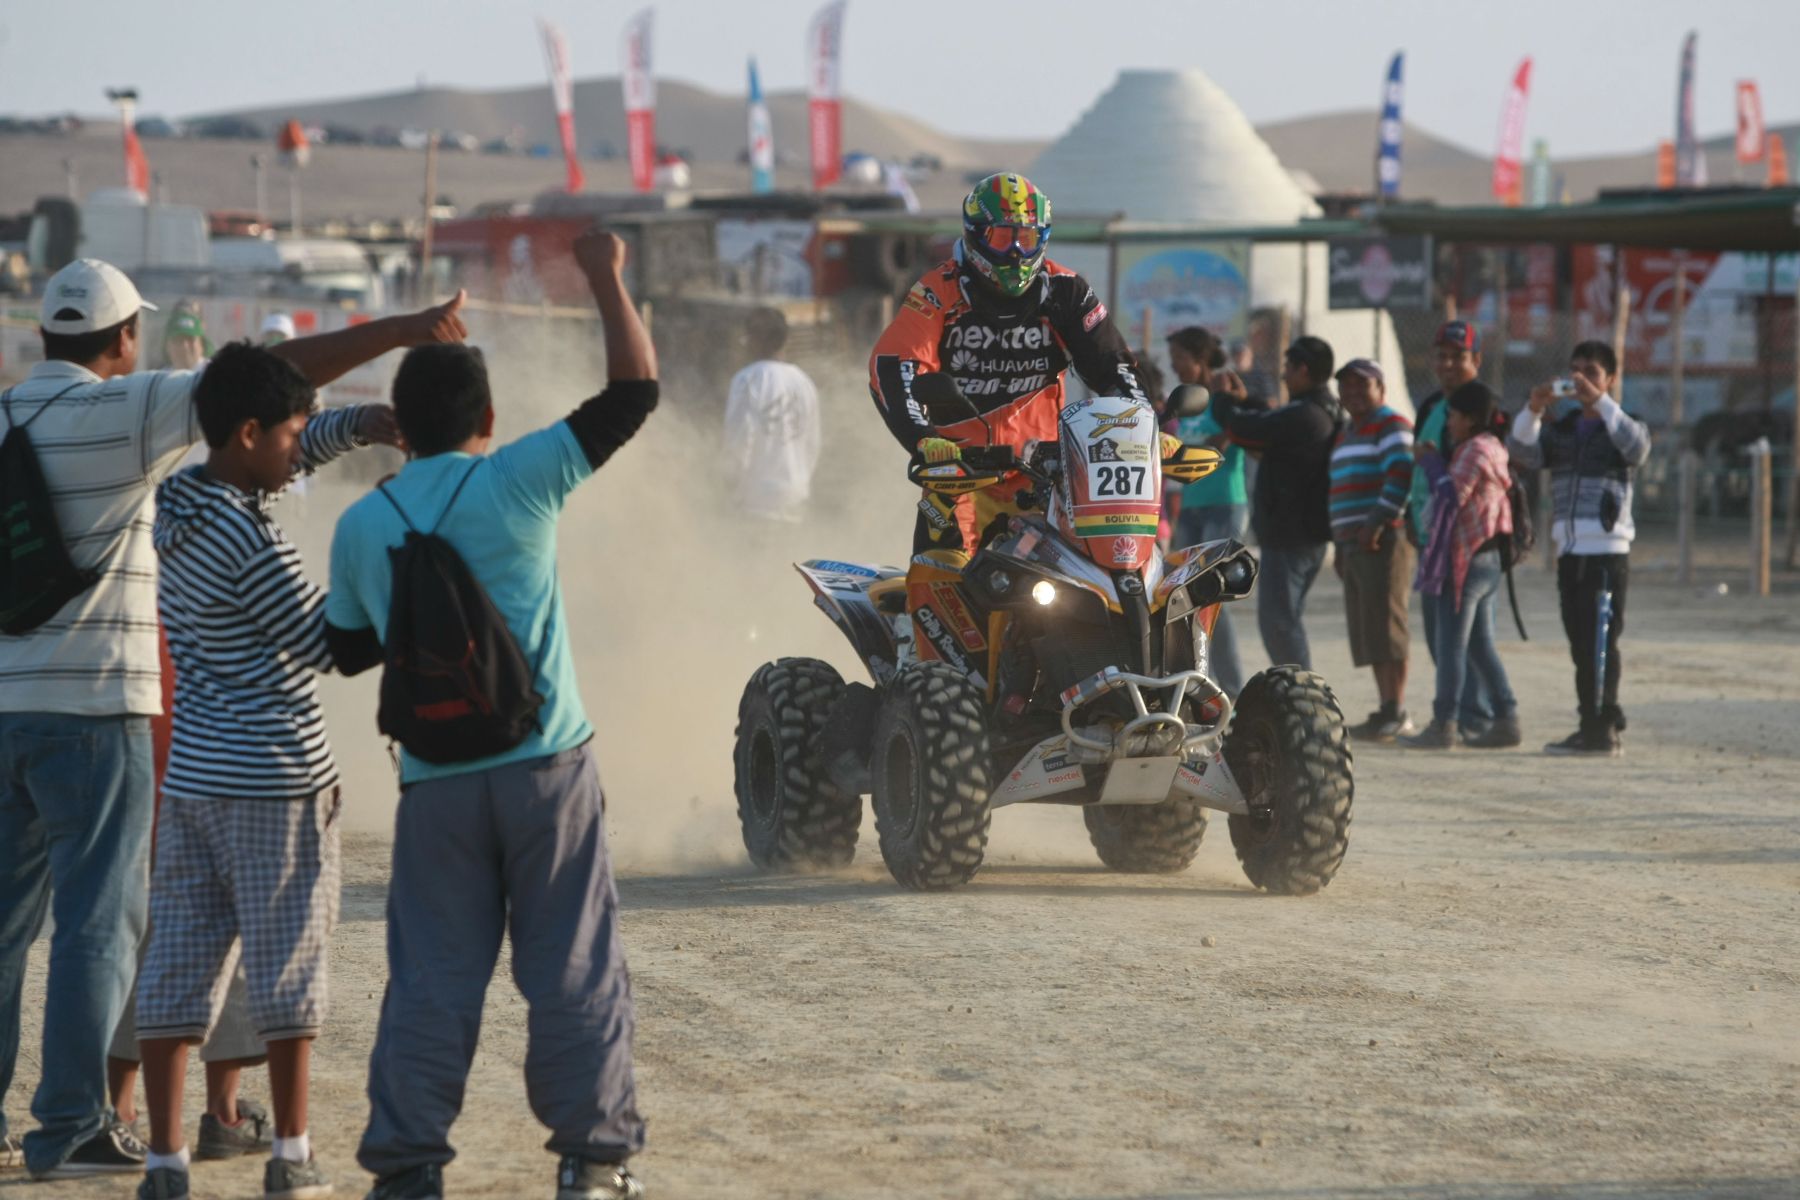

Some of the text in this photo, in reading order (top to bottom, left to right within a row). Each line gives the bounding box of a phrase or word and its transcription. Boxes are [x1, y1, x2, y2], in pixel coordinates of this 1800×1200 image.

[945, 324, 1052, 350] nextel
[981, 357, 1049, 374] HUAWEI
[1097, 466, 1146, 497] 287
[1104, 514, 1141, 525] BOLIVIA
[821, 560, 869, 576] Macro
[1047, 769, 1081, 785] nextel
